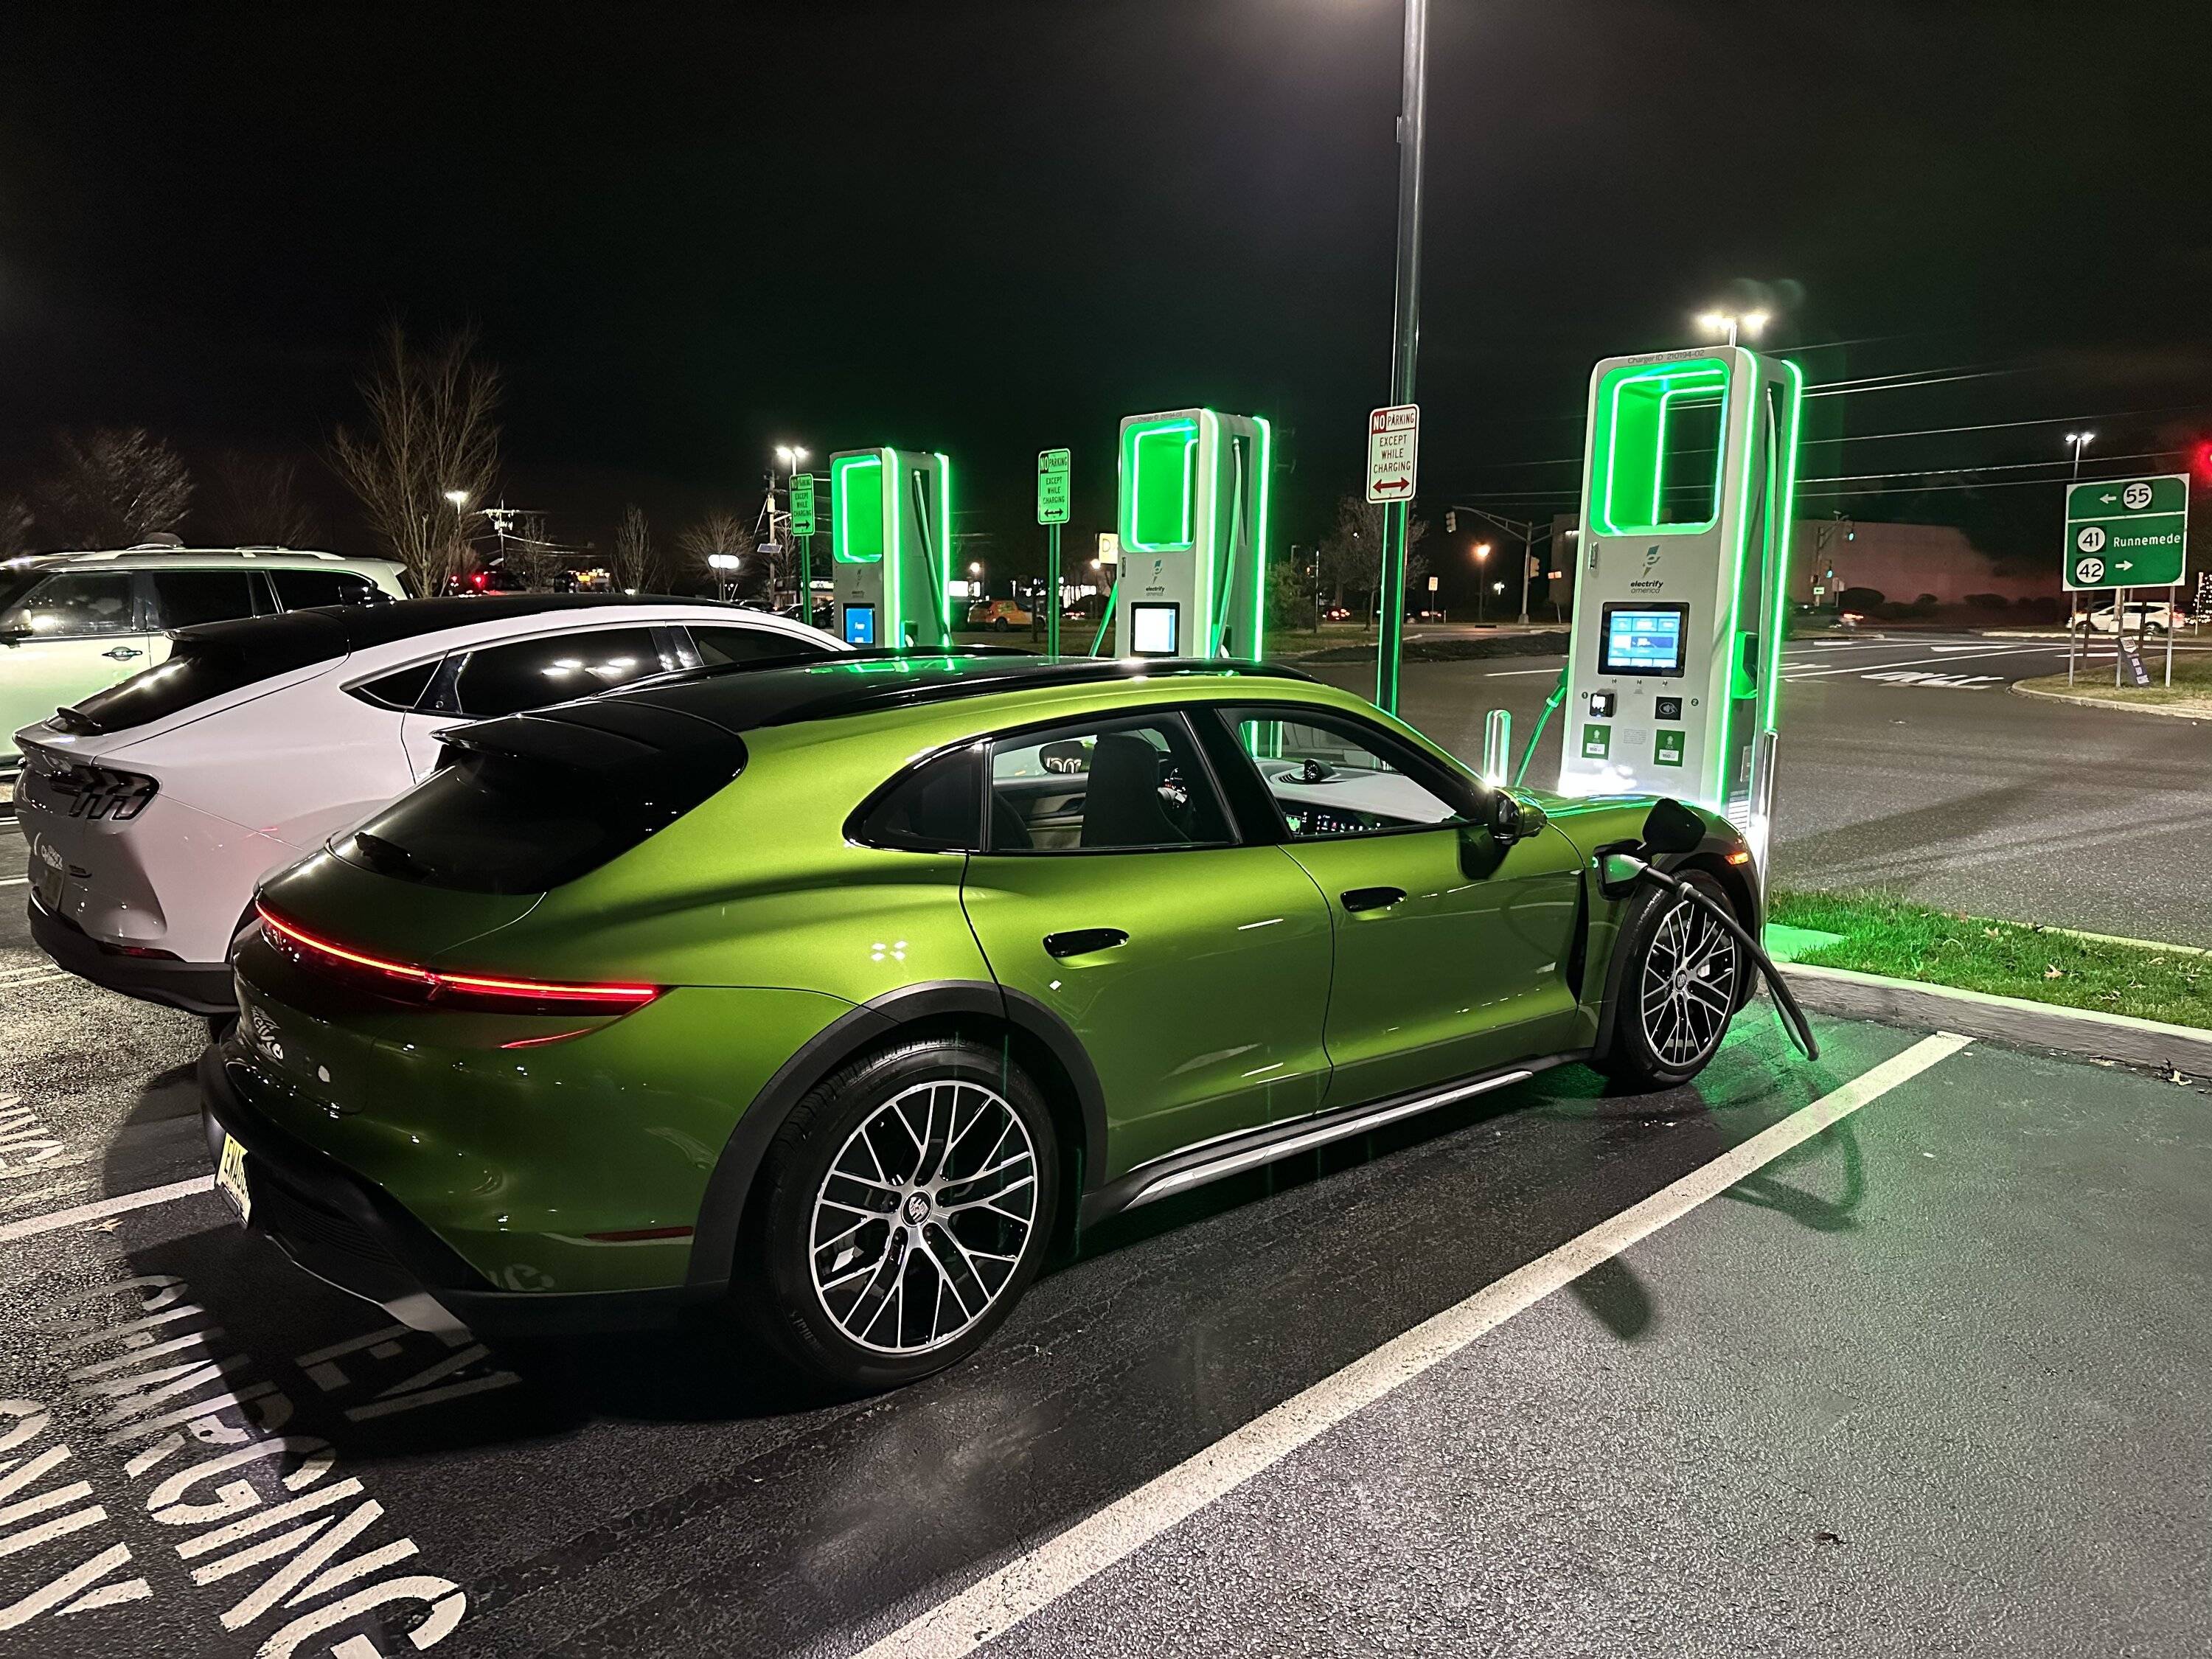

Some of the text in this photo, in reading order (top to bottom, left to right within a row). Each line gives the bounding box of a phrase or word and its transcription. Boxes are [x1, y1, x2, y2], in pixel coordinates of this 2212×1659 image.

[1374, 413, 1414, 431] NO PARKING
[1380, 434, 1407, 447] EXCEPT
[1382, 448, 1404, 459] WHILE
[1040, 456, 1067, 470] NO PARKING
[1374, 461, 1411, 473] CHARGING
[1046, 476, 1062, 484] EXCEPT
[1043, 495, 1065, 504] CHARGING
[2126, 487, 2149, 504] 55
[2082, 532, 2181, 548] 41 Runnemede
[2079, 563, 2101, 578] 42
[1630, 580, 1663, 588] electrify
[29, 1275, 467, 1659] CHARGING
